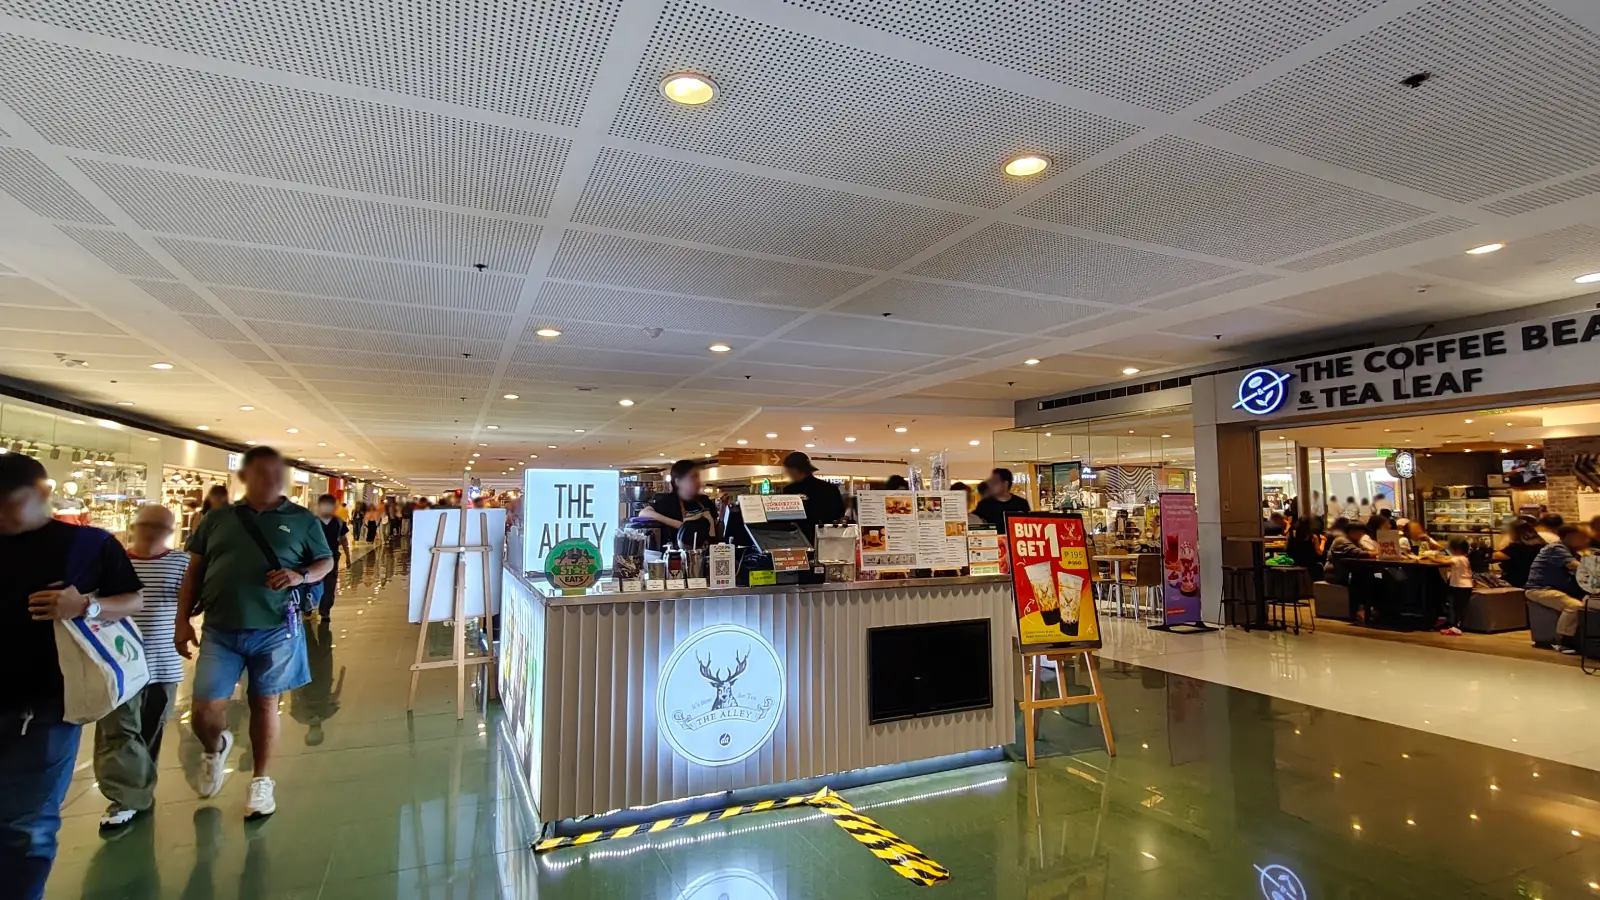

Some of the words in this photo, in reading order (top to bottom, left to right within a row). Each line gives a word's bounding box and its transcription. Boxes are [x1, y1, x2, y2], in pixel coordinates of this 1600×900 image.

[1295, 356, 1354, 382] THE
[1364, 331, 1507, 373] COFFEE
[1298, 390, 1315, 406] &
[1320, 382, 1383, 407] TEA
[1393, 368, 1483, 400] LEAF
[554, 484, 594, 518] THE
[1014, 523, 1043, 538] BUY
[1044, 523, 1060, 558] 1
[1016, 541, 1046, 557] GET
[565, 575, 584, 583] EATS
[696, 713, 717, 726] THE
[720, 709, 752, 719] ALLEY
